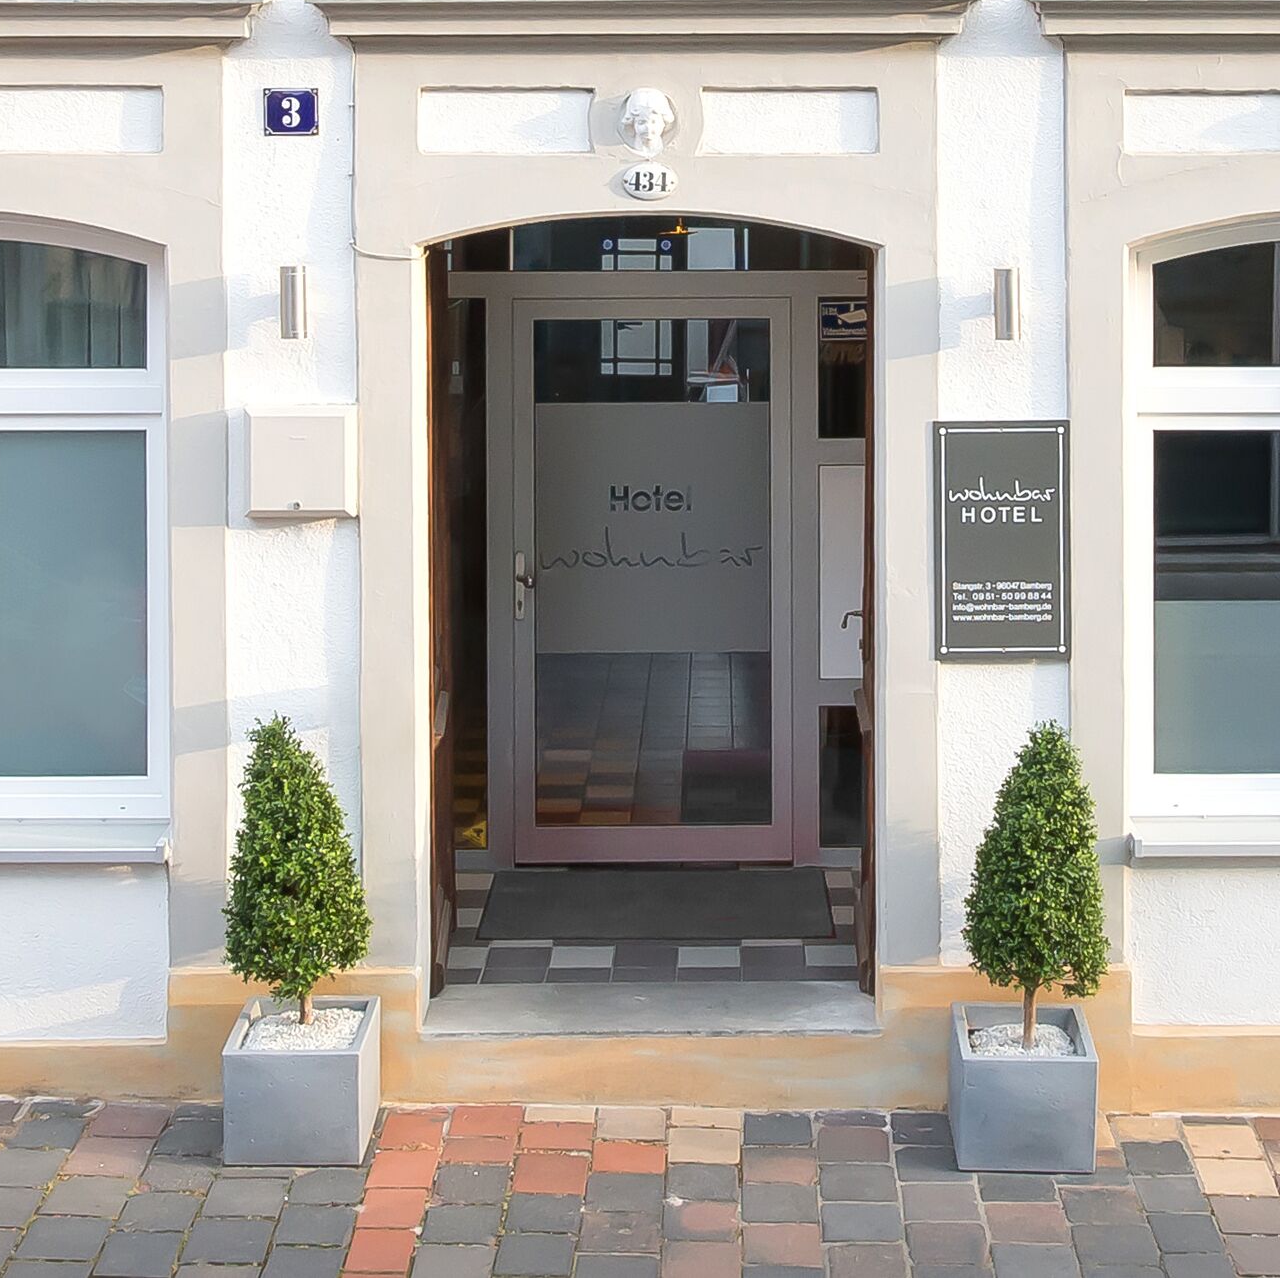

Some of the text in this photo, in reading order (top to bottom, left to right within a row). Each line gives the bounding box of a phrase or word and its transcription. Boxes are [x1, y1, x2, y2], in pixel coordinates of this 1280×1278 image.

[281, 96, 301, 128] 3
[609, 484, 692, 512] Hotel
[948, 476, 1056, 503] wohnbar
[961, 506, 1043, 523] HOTEL
[539, 526, 763, 571] wohnbar
[952, 592, 968, 601] Tel.
[1020, 581, 1052, 591] Bamberg
